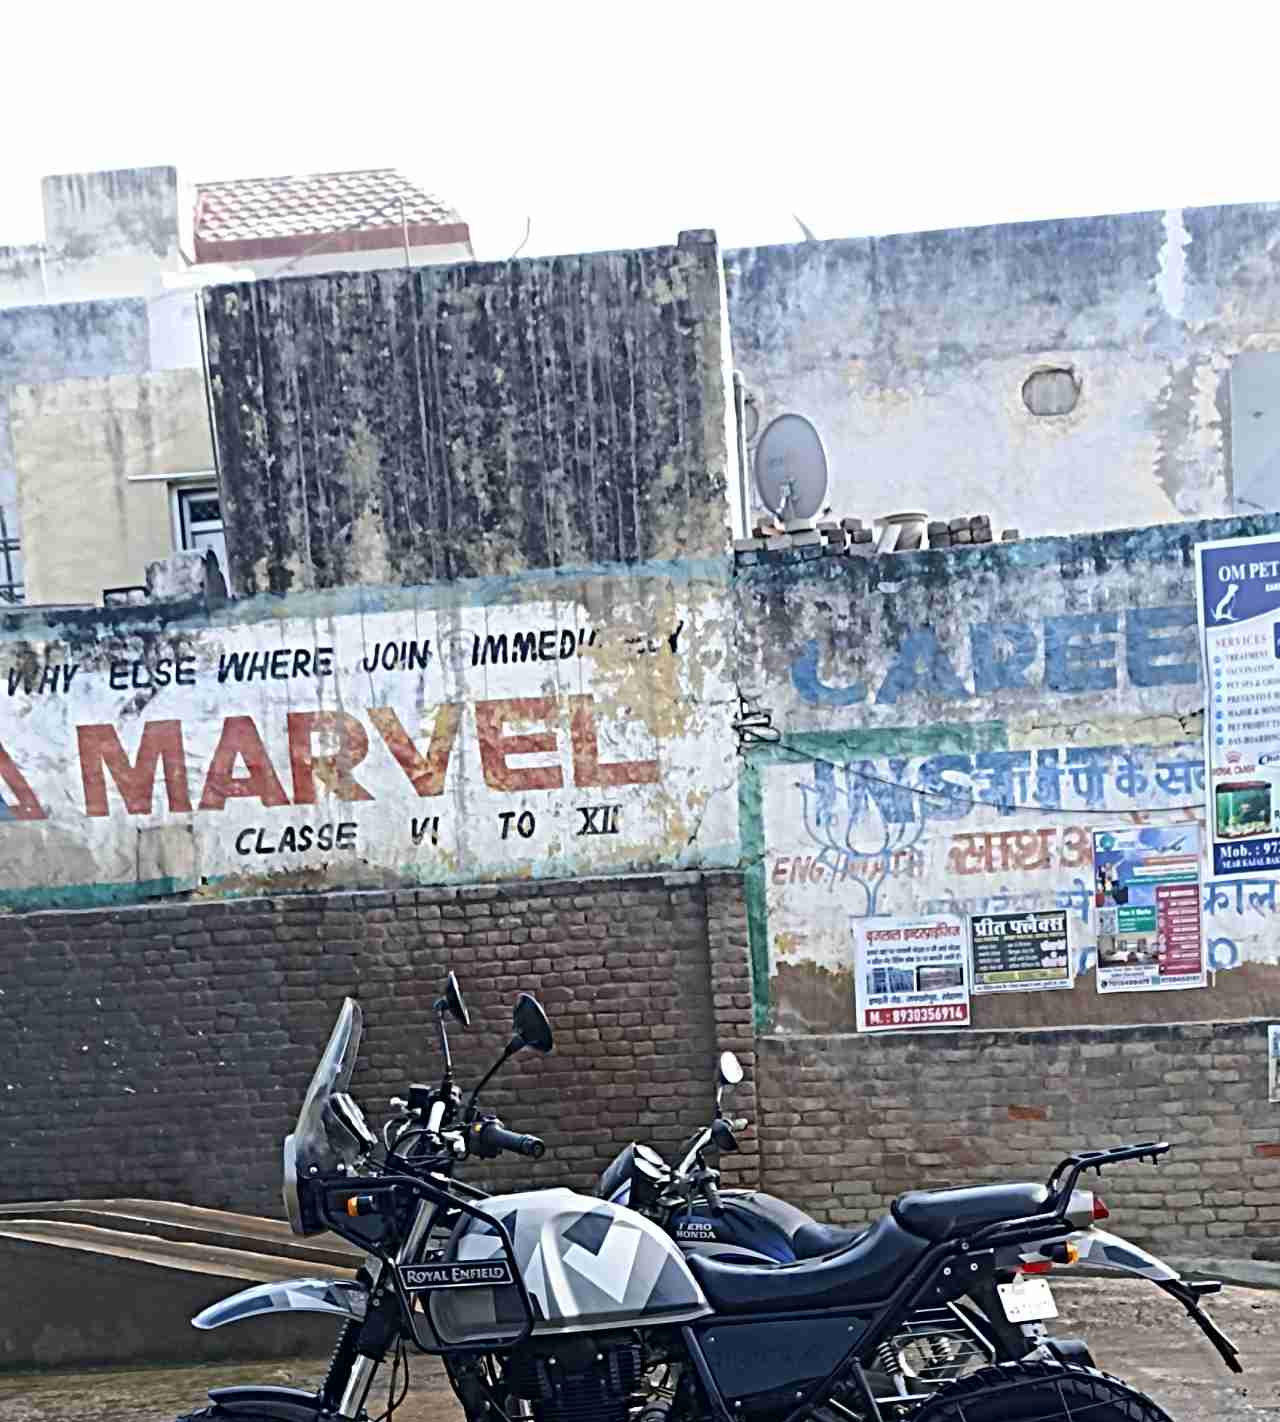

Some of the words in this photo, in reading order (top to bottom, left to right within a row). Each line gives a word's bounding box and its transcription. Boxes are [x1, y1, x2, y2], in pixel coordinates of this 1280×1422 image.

[1218, 564, 1246, 582] OM
[8, 663, 80, 697] WHY
[109, 656, 196, 690] ELSE
[218, 647, 334, 683] WHERE
[363, 638, 430, 673] JOIN
[77, 692, 660, 817] MARVEL
[235, 822, 358, 856] CLASSE
[410, 816, 439, 846] VI
[500, 810, 535, 840] TO
[1220, 845, 1252, 859] Mob.
[892, 1005, 963, 1024] 8930356914
[676, 1230, 716, 1239] HONDA
[407, 1270, 449, 1283] ROYAL
